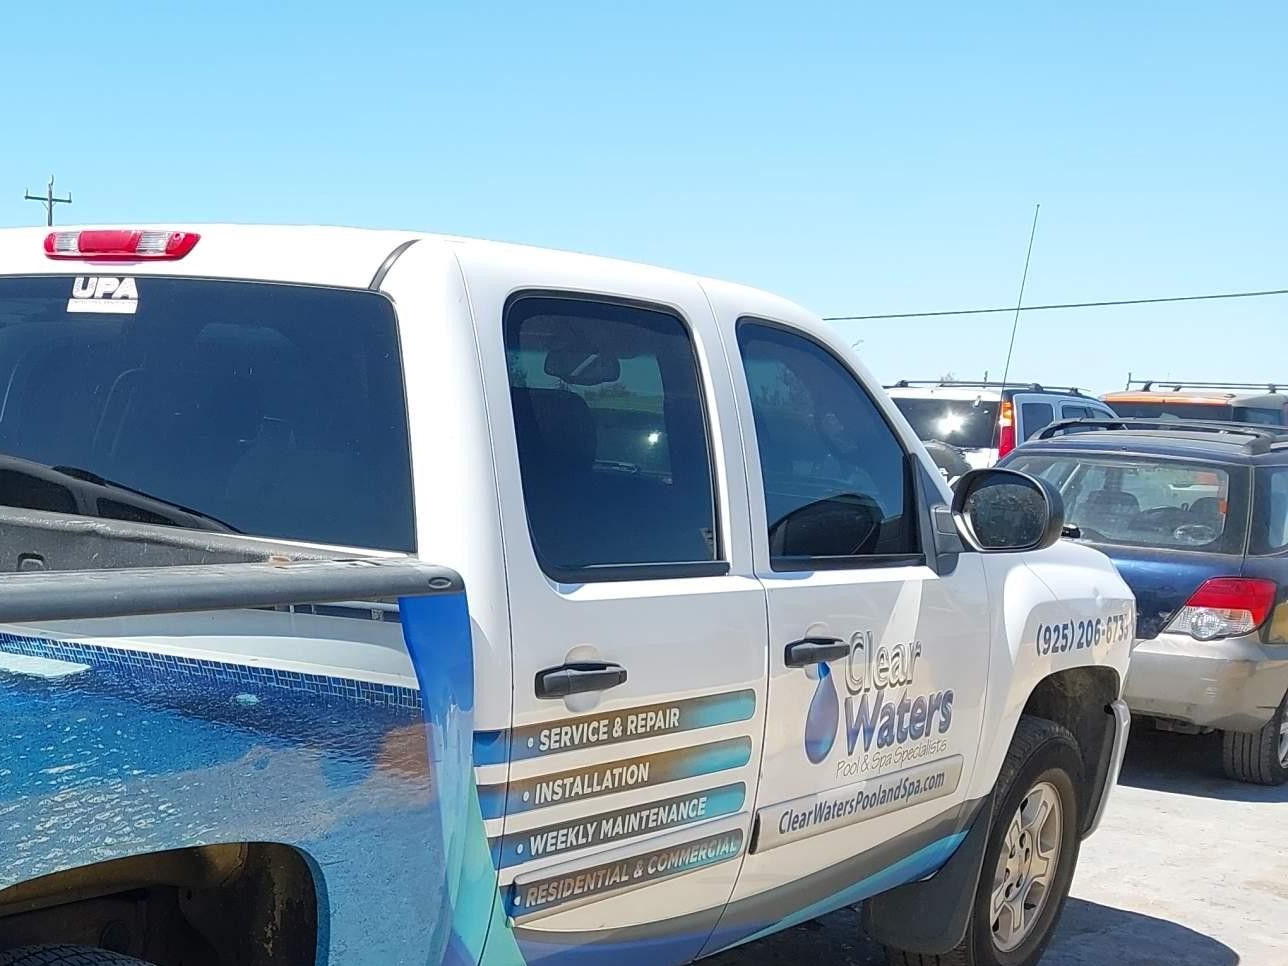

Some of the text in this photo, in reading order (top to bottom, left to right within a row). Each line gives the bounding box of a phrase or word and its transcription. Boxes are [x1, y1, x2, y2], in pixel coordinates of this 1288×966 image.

[72, 276, 139, 299] UPA
[844, 631, 923, 696] Clear
[1036, 619, 1075, 657] (925)
[539, 708, 680, 752] SERVICE & REPAIR
[844, 687, 956, 757] Waters
[535, 762, 650, 805] INSTALLATION
[835, 738, 948, 780] Pool & Spa Specialists
[529, 796, 708, 856] WEEKLY MAINTENANCE
[778, 771, 946, 835] ClearWatersPoolandSpa.com
[525, 837, 738, 908] RESIDENTIAL & COMMERCIAL
